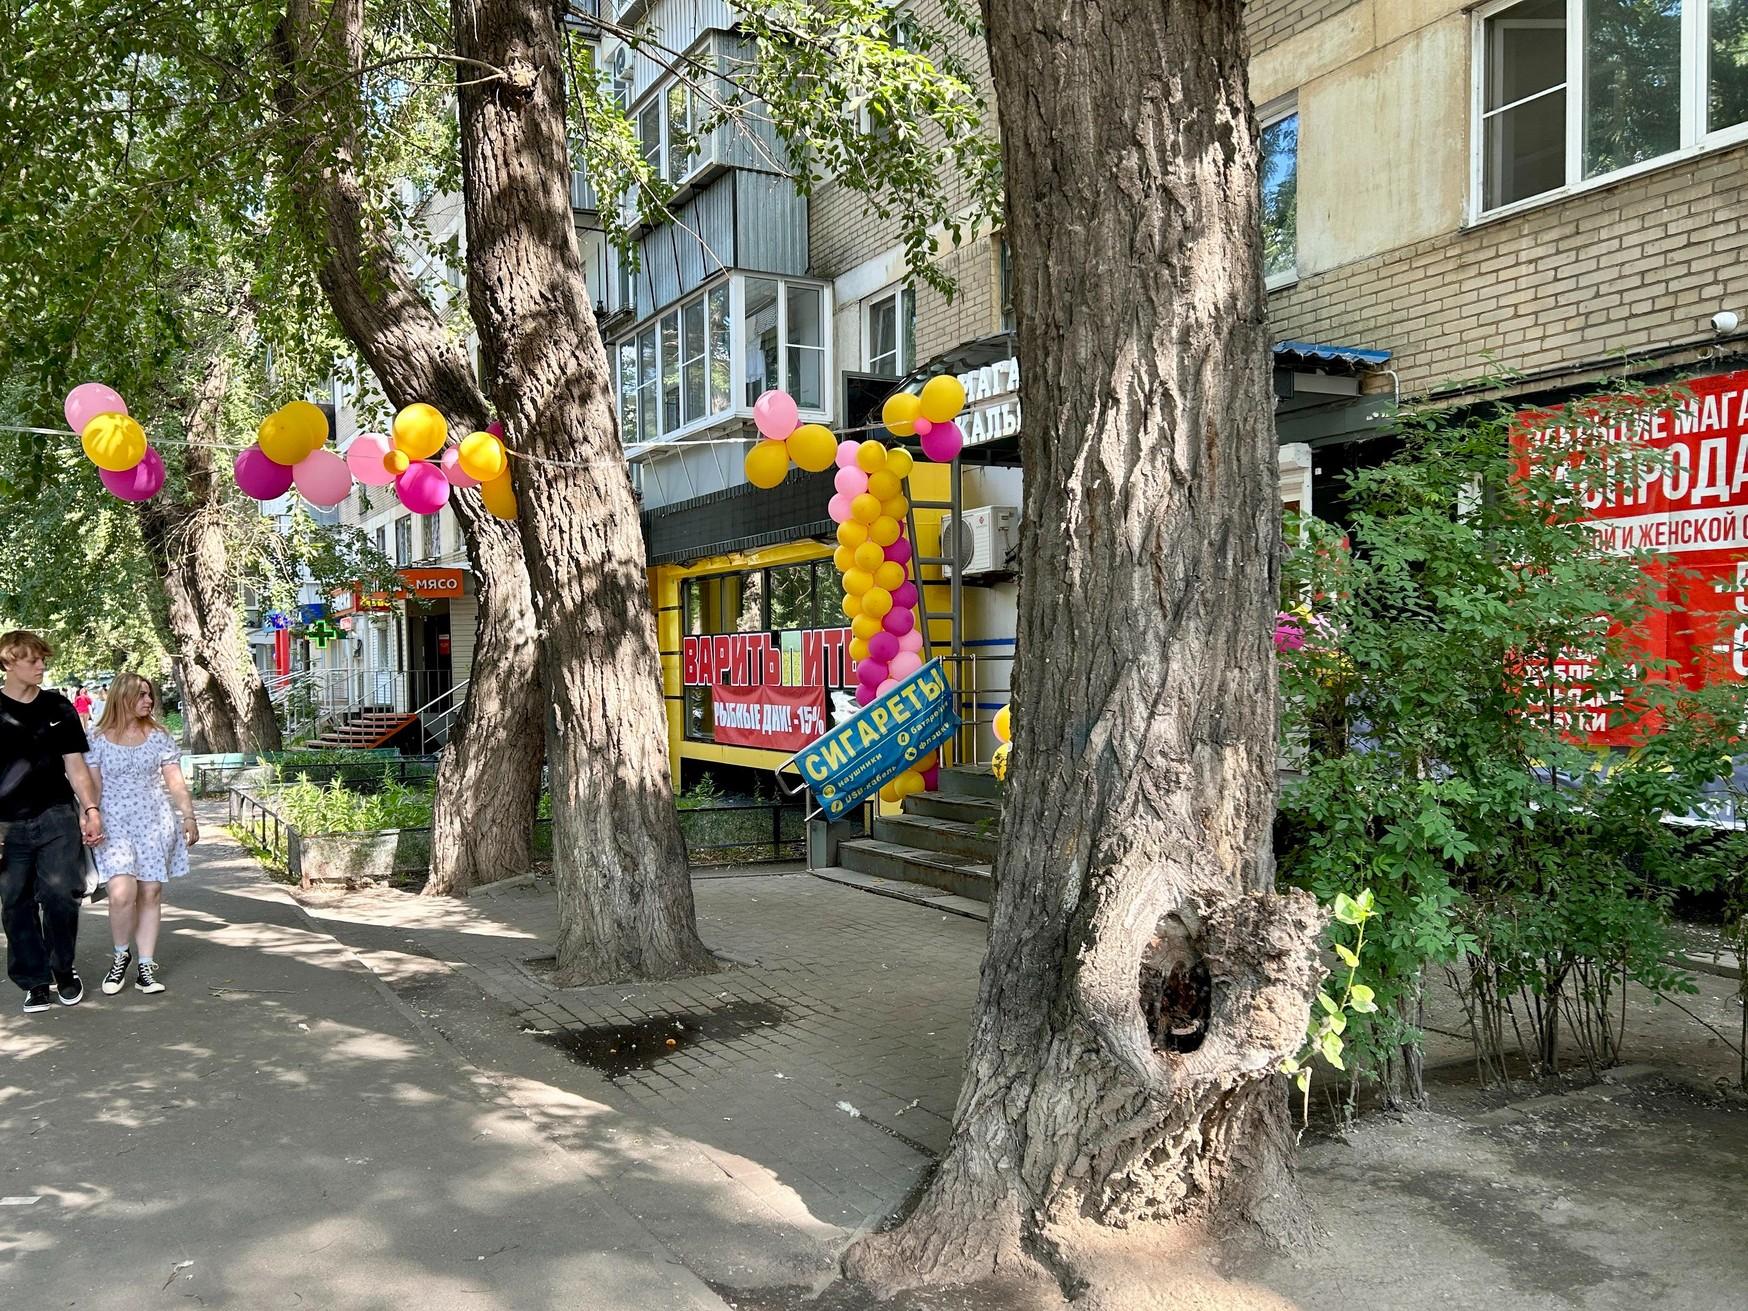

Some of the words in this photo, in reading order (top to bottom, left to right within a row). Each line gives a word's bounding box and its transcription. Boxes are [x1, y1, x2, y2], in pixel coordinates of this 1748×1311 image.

[955, 401, 1021, 446] КАЛЬ
[1639, 511, 1737, 547] ЖЕНСКОЙ
[416, 579, 457, 590] МЯСО
[714, 701, 760, 730] РЫБНЫЕ
[762, 704, 792, 735] ДНИ!
[805, 668, 945, 781] СИГАРЕТЫ
[838, 753, 882, 788] наушники
